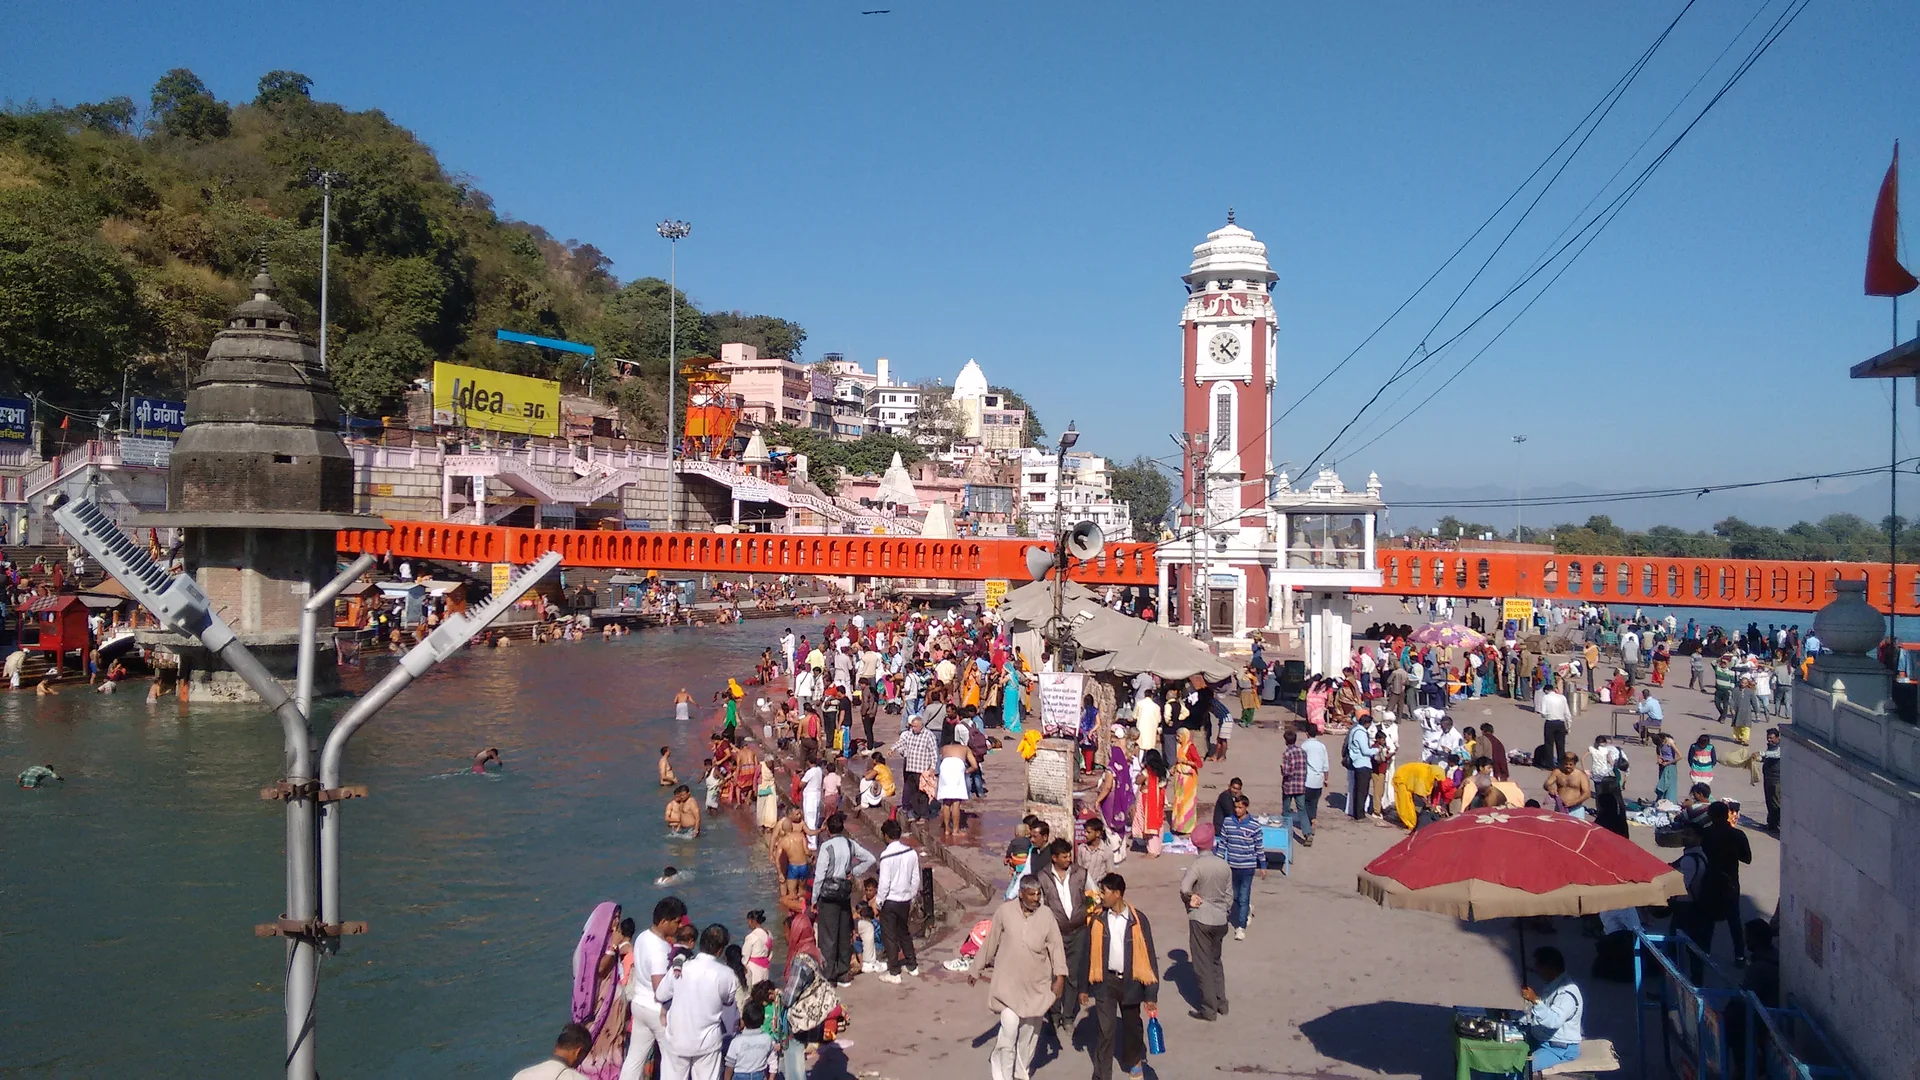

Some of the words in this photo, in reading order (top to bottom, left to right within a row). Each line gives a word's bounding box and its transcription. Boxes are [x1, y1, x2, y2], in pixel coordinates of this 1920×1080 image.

[136, 400, 152, 423] श्री
[153, 403, 179, 426] गंगा
[452, 378, 504, 414] Idea
[523, 402, 545, 419] 3G
